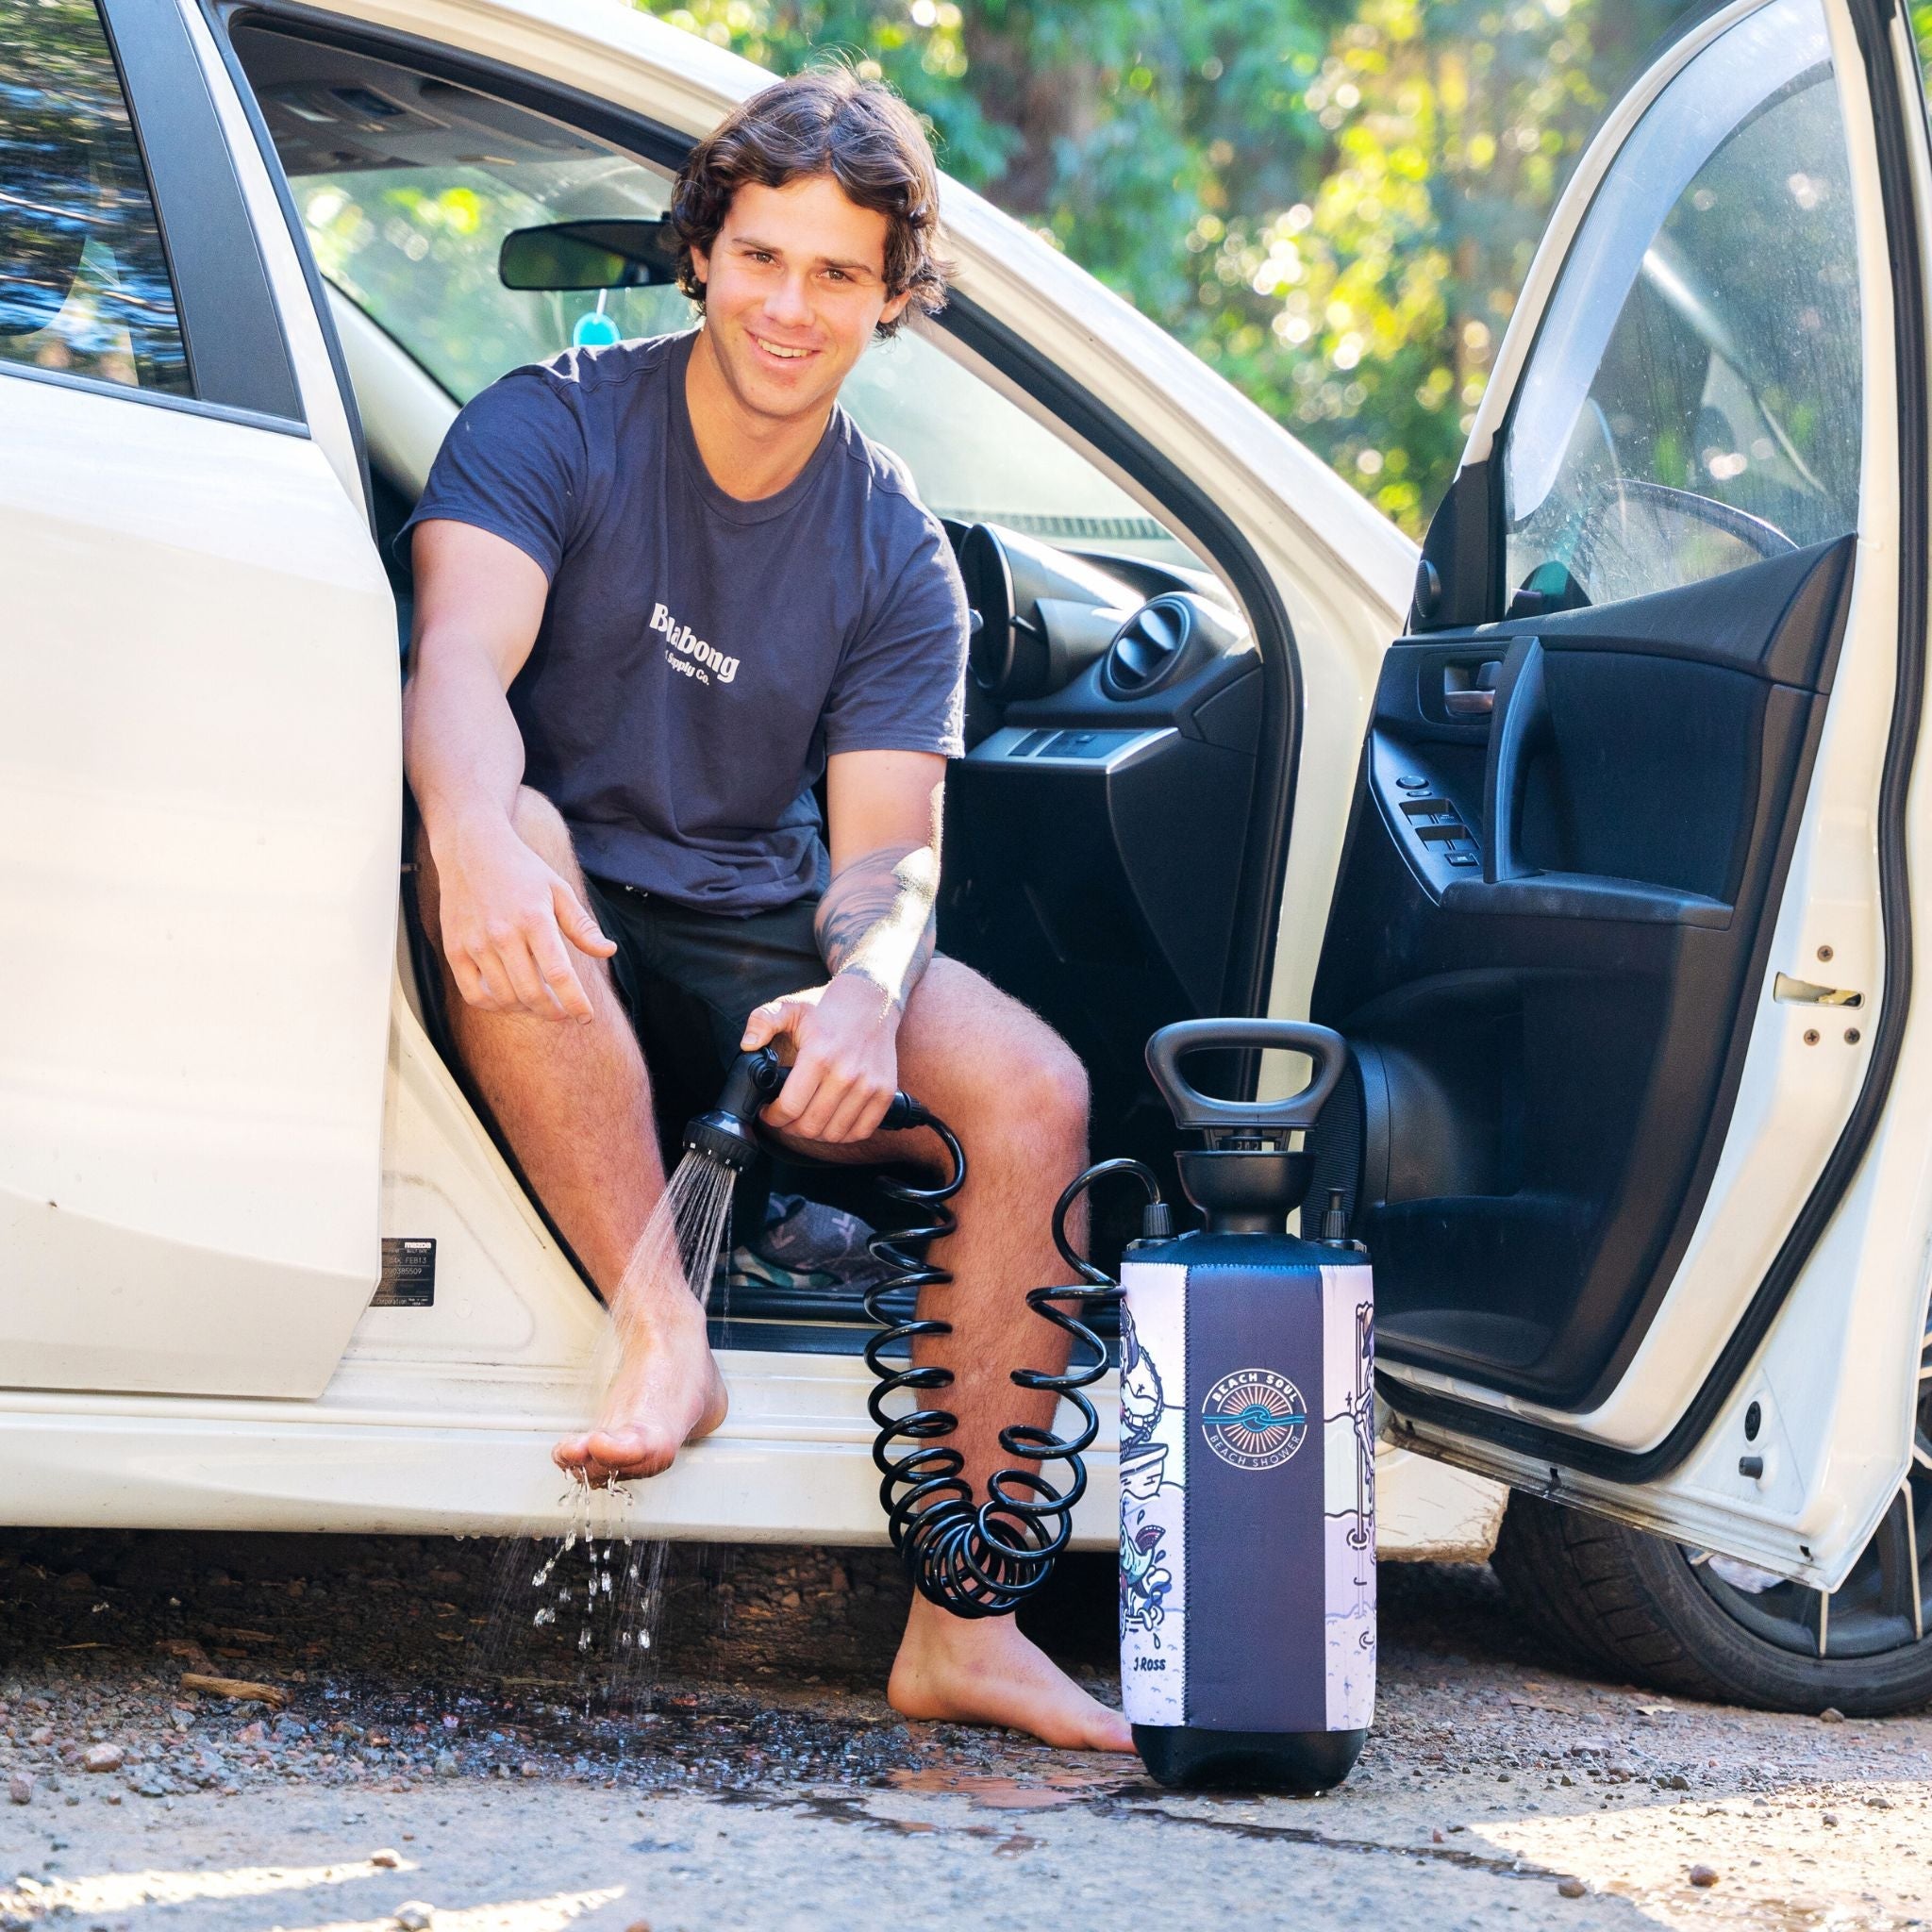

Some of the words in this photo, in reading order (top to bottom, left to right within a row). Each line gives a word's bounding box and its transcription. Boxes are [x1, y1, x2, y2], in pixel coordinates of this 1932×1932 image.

[695, 668, 709, 686] Co.
[1211, 1373, 1257, 1402] BEACH
[1266, 1374, 1298, 1403] SOUL
[1209, 1435, 1247, 1466] BEACH
[1252, 1435, 1300, 1467] SHOWER
[1140, 1657, 1166, 1672] ROSS
